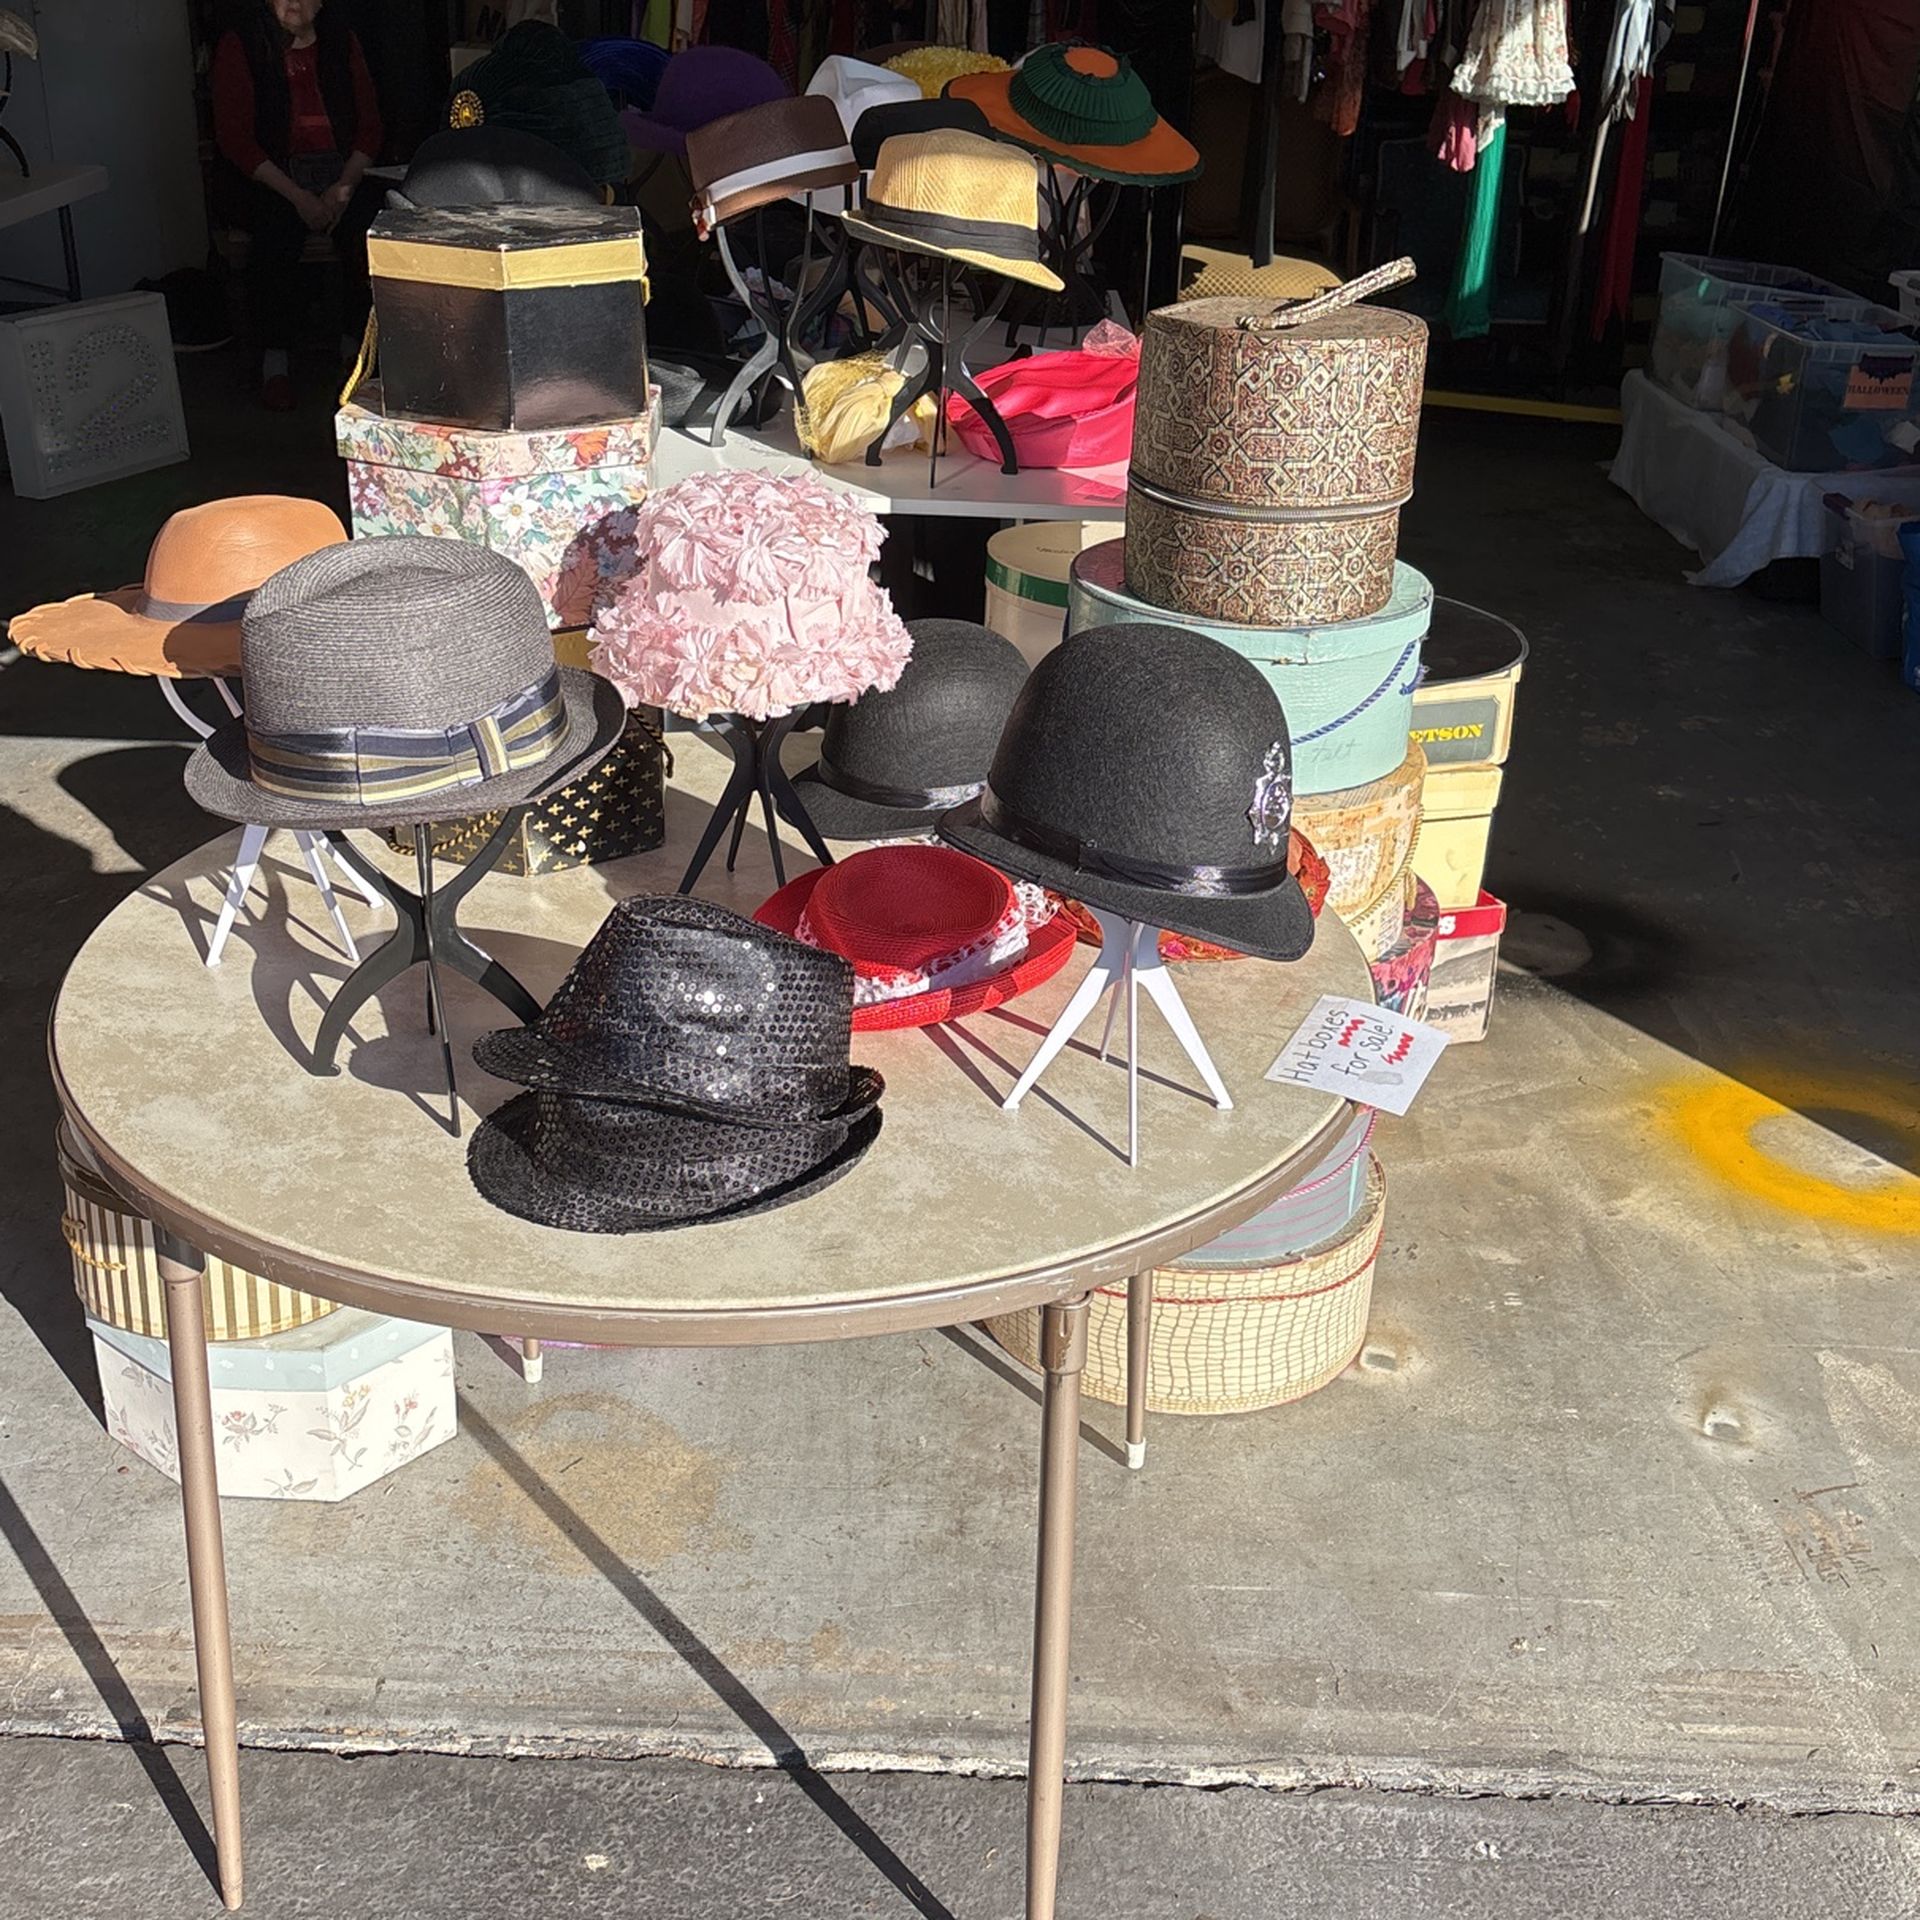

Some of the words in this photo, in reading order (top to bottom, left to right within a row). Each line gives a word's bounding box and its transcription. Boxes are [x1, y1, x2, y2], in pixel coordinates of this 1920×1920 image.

[1409, 723, 1485, 743] ETSON
[1331, 1052, 1370, 1076] for
[1359, 1013, 1394, 1052] sale!
